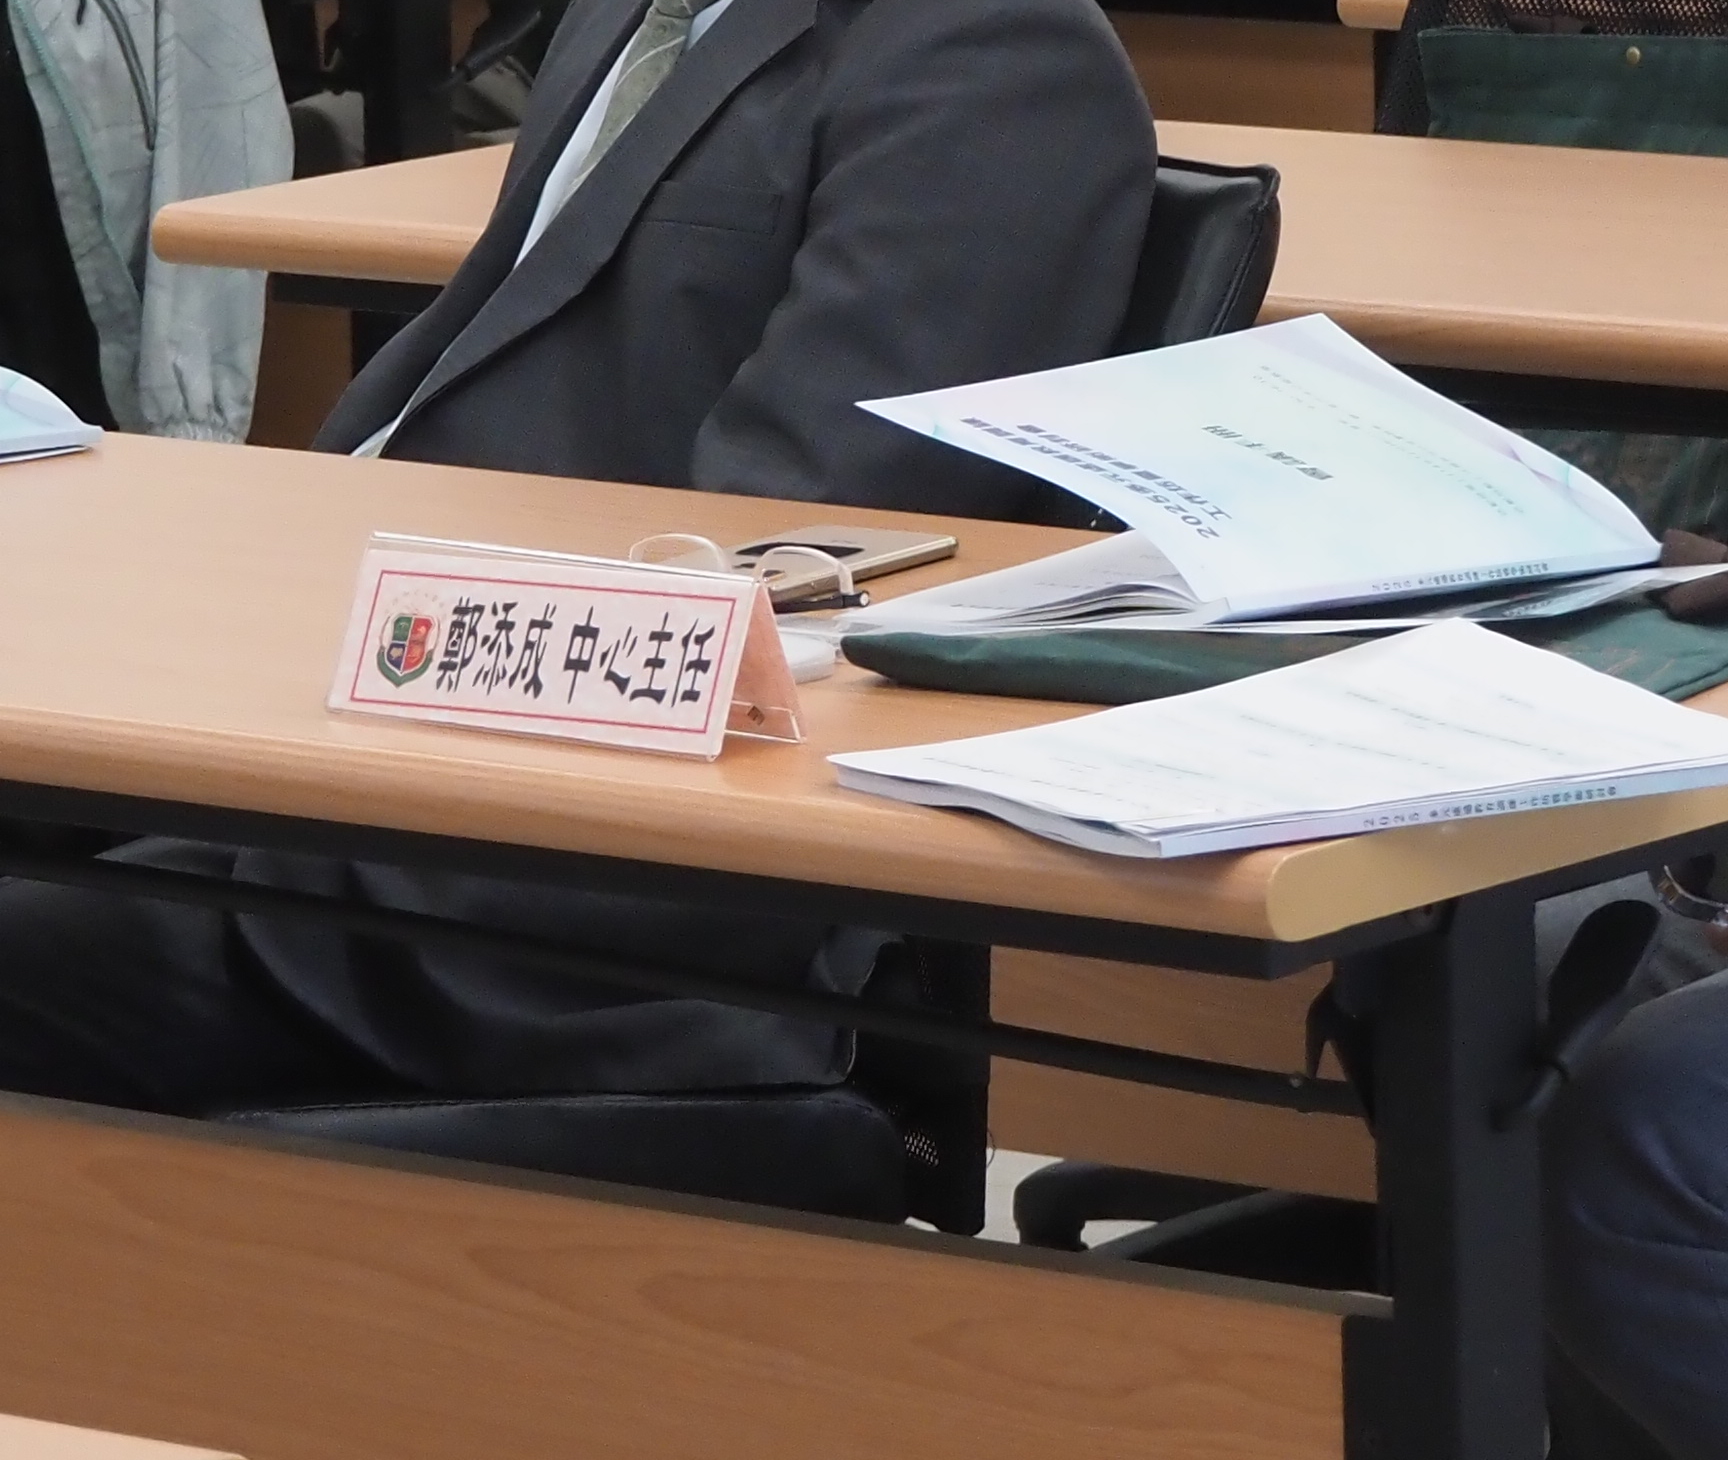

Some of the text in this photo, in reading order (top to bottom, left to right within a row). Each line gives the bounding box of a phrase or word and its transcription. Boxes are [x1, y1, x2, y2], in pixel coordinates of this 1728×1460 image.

[435, 595, 716, 709] 鄭添成 中心主任
